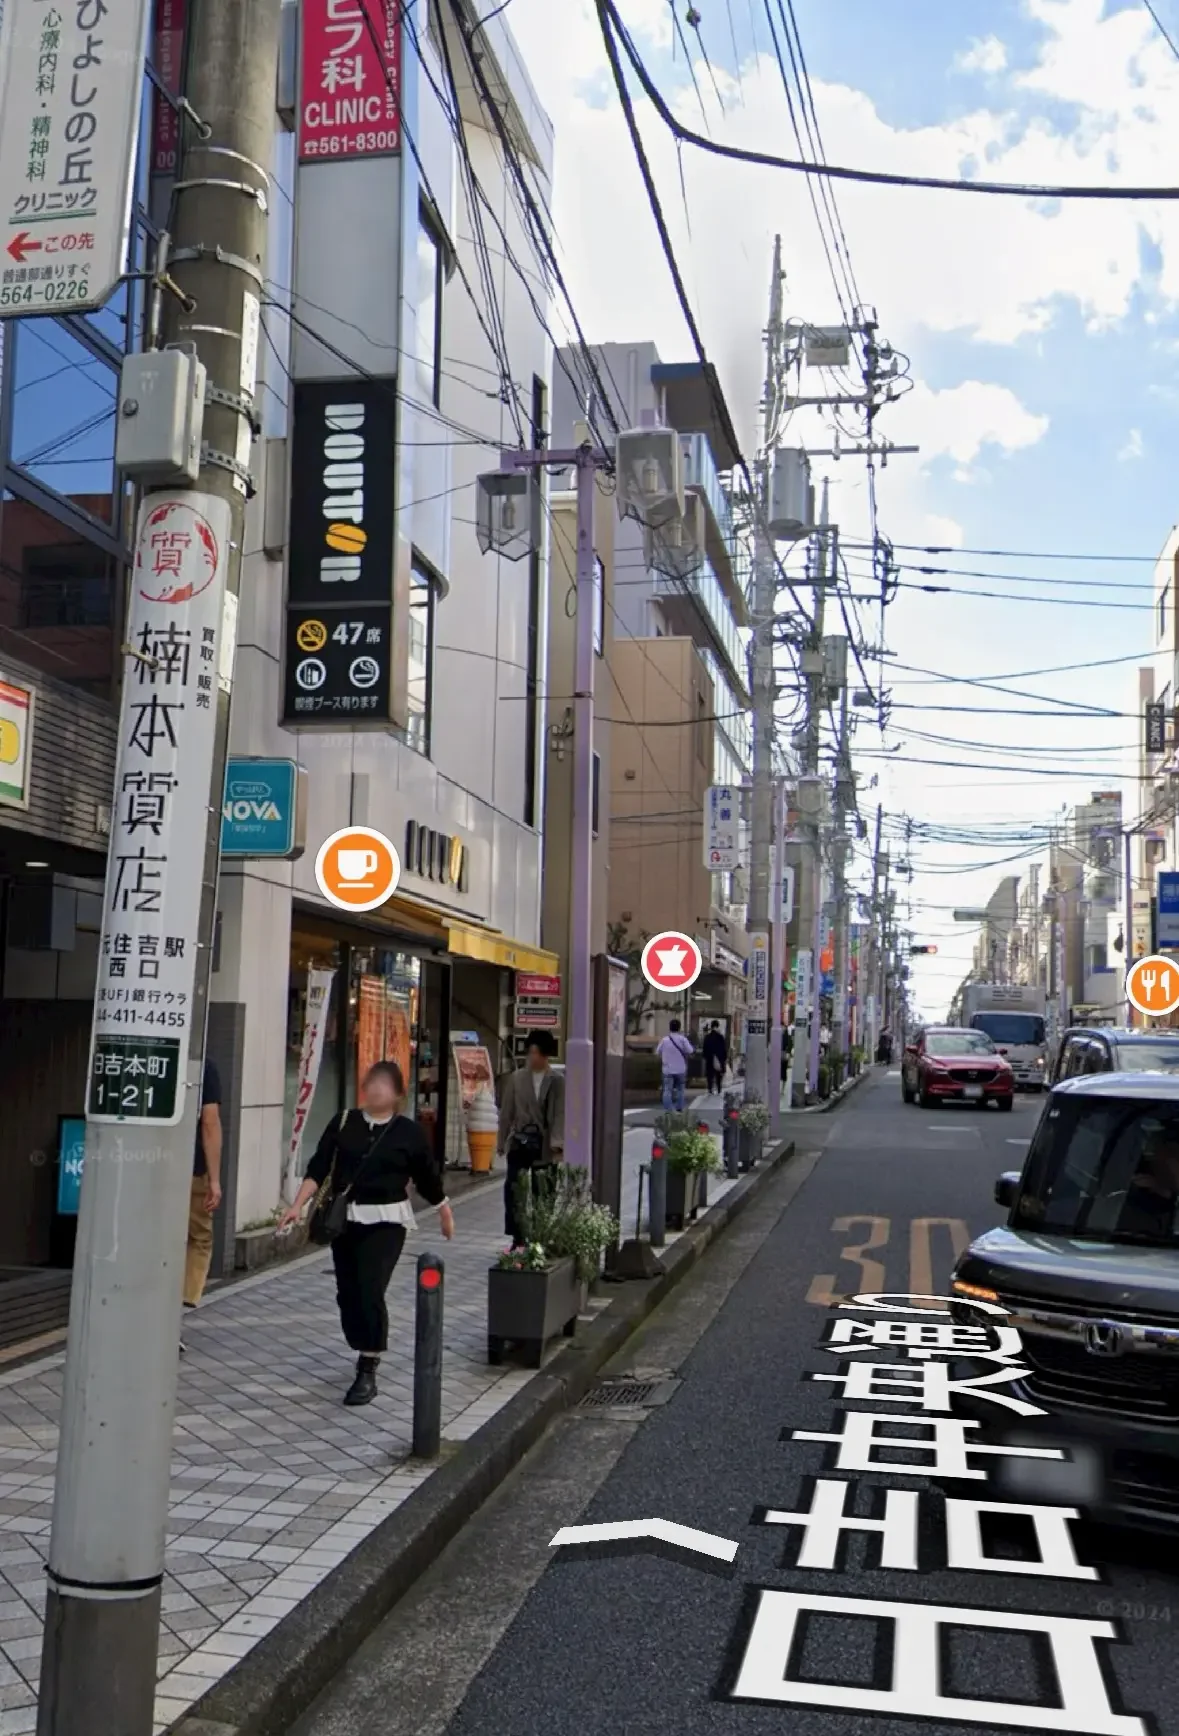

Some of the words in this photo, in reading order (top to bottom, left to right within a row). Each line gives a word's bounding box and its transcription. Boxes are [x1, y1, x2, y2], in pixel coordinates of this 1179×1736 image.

[25, 8, 62, 182] 心療内科・精神科
[58, 0, 108, 186] ひよしの丘
[304, 96, 381, 128] CLINIC
[319, 130, 398, 155] 561-8300
[14, 187, 98, 214] クリニック
[45, 232, 95, 253] この先
[0, 280, 89, 305] 564-0226
[319, 403, 368, 582] DOUTOR
[150, 530, 192, 577] 質
[196, 626, 215, 709] 買取・販売
[111, 621, 191, 913] 楠本質店
[222, 800, 282, 822] NOVA
[109, 957, 159, 979] 西口
[94, 1053, 170, 1079] 日吉本町
[97, 1083, 154, 1109] 1-21
[805, 1214, 972, 1311] 30
